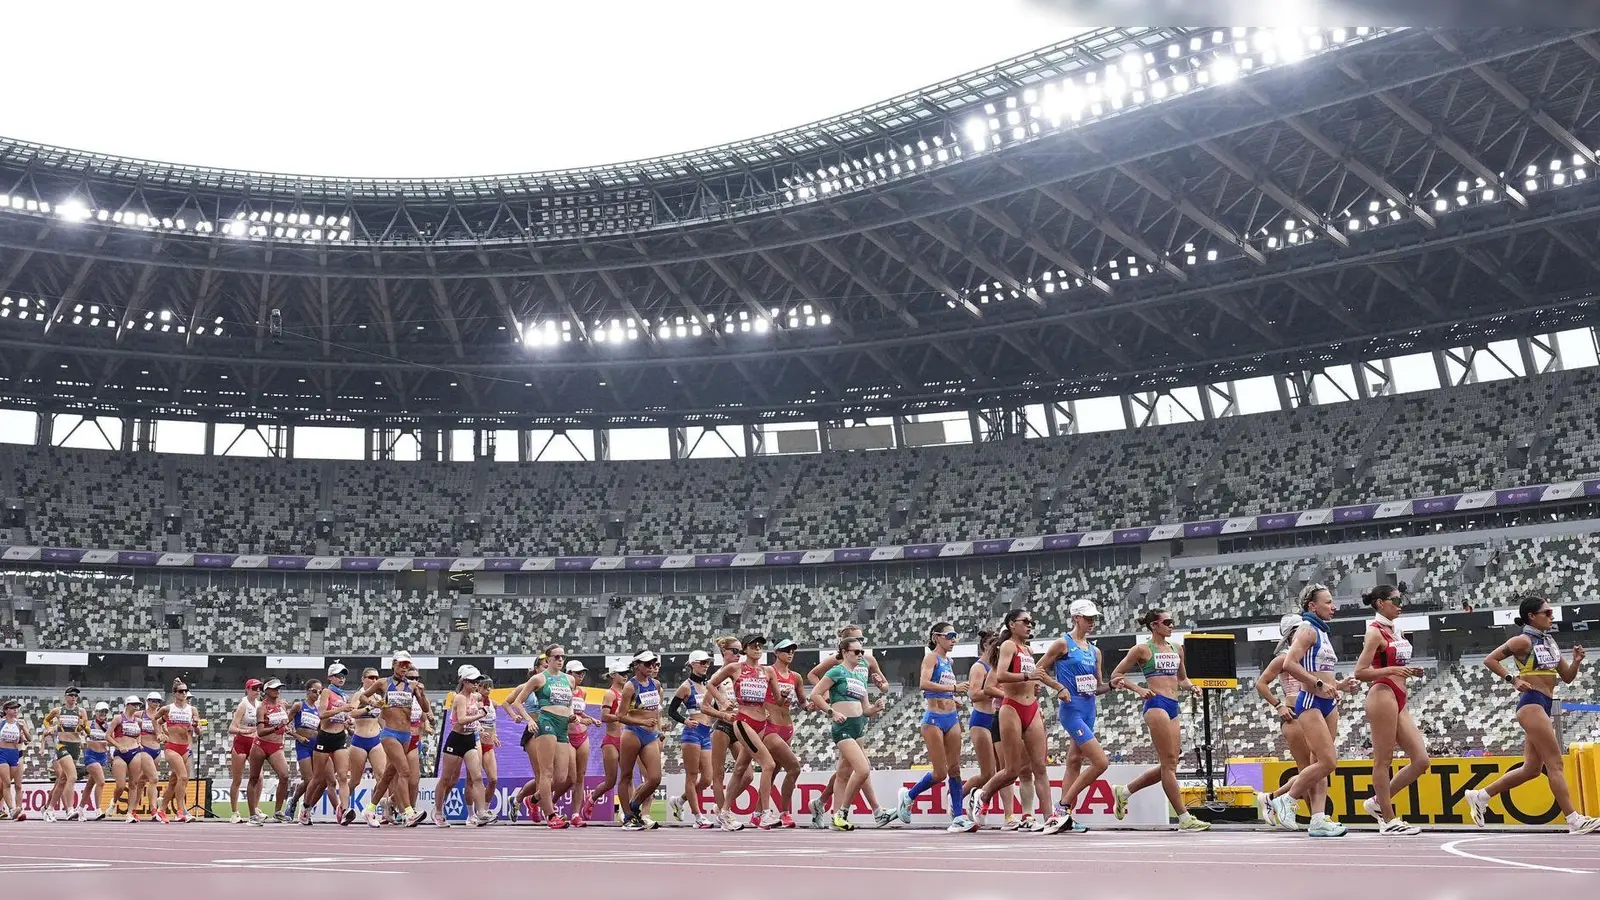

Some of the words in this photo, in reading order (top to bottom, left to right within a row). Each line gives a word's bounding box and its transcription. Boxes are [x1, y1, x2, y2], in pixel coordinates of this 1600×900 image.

[21, 789, 95, 811] HOA
[692, 784, 873, 815] HONDA
[903, 779, 1128, 814] HNDA
[1279, 762, 1566, 824] SEIKO
